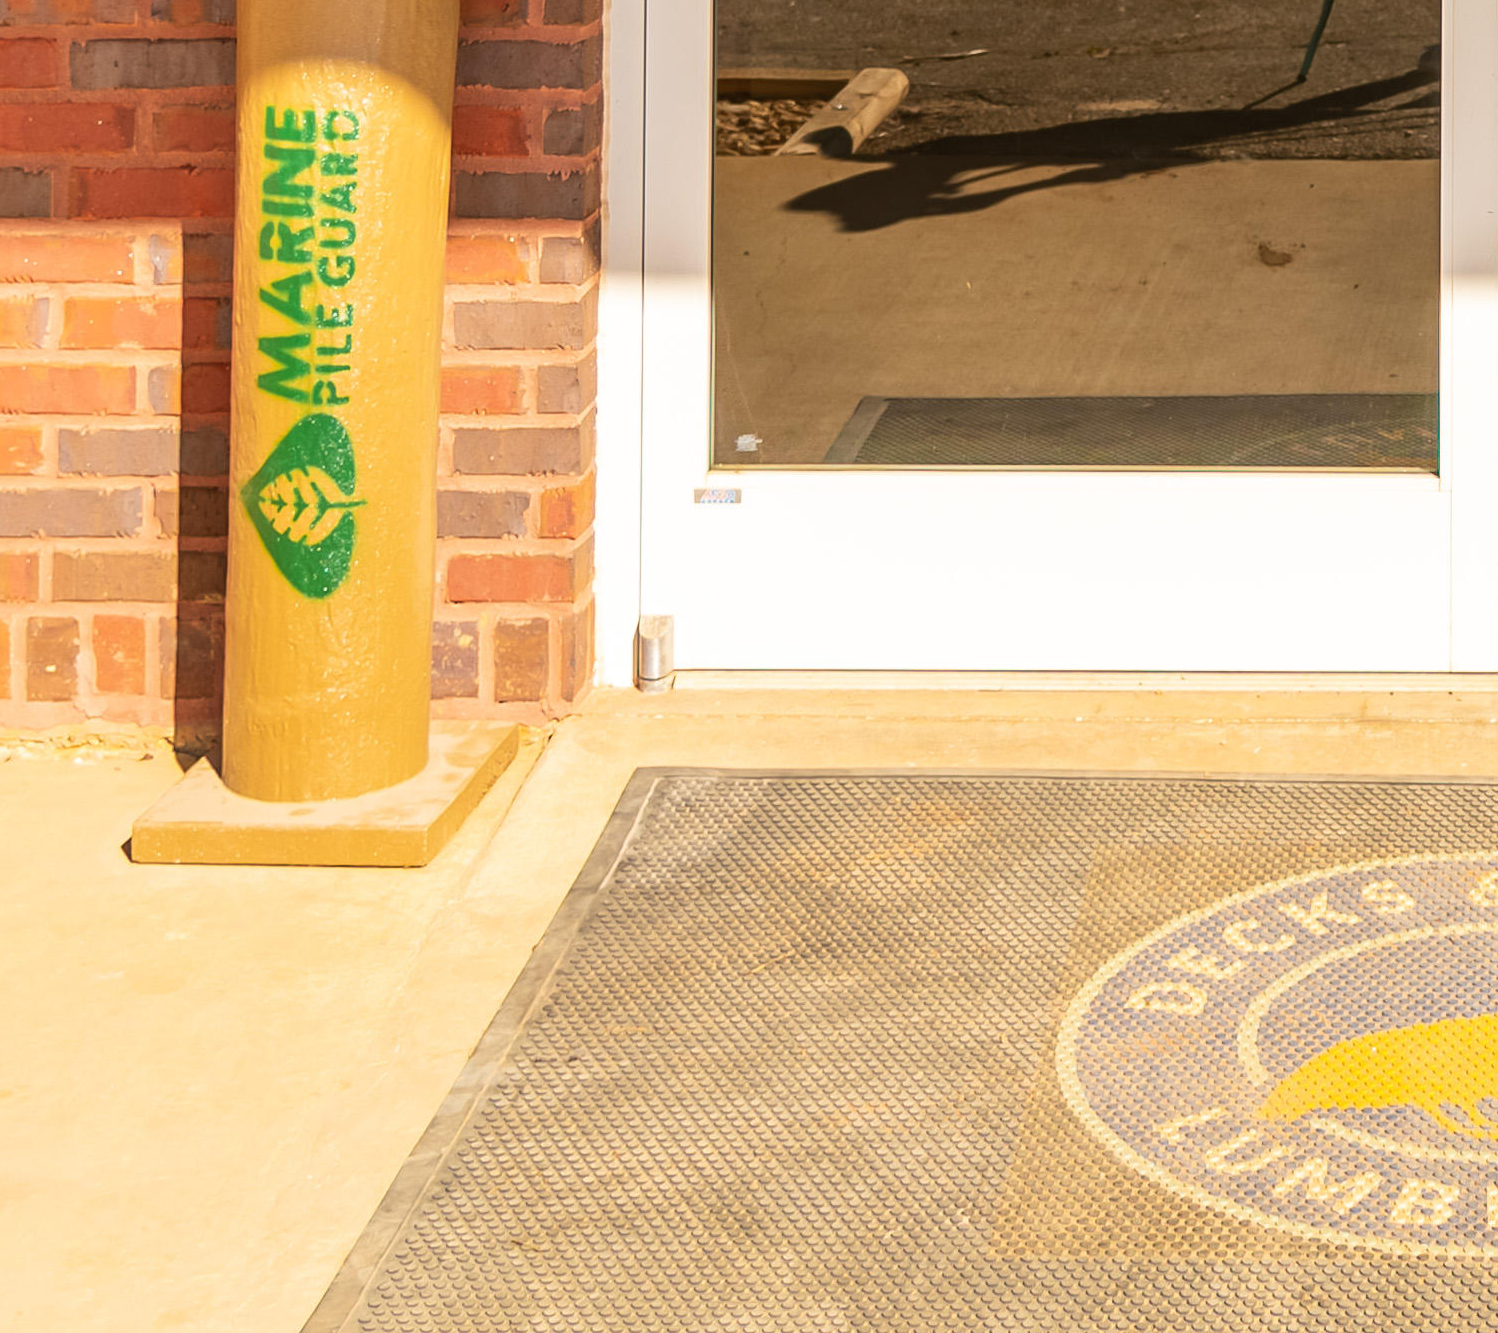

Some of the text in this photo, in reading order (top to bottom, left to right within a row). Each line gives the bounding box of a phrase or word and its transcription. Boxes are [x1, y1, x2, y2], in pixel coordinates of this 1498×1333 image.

[256, 105, 317, 405] MARINE
[311, 108, 360, 407] PILE GUARD
[1124, 879, 1415, 1016] DECKS
